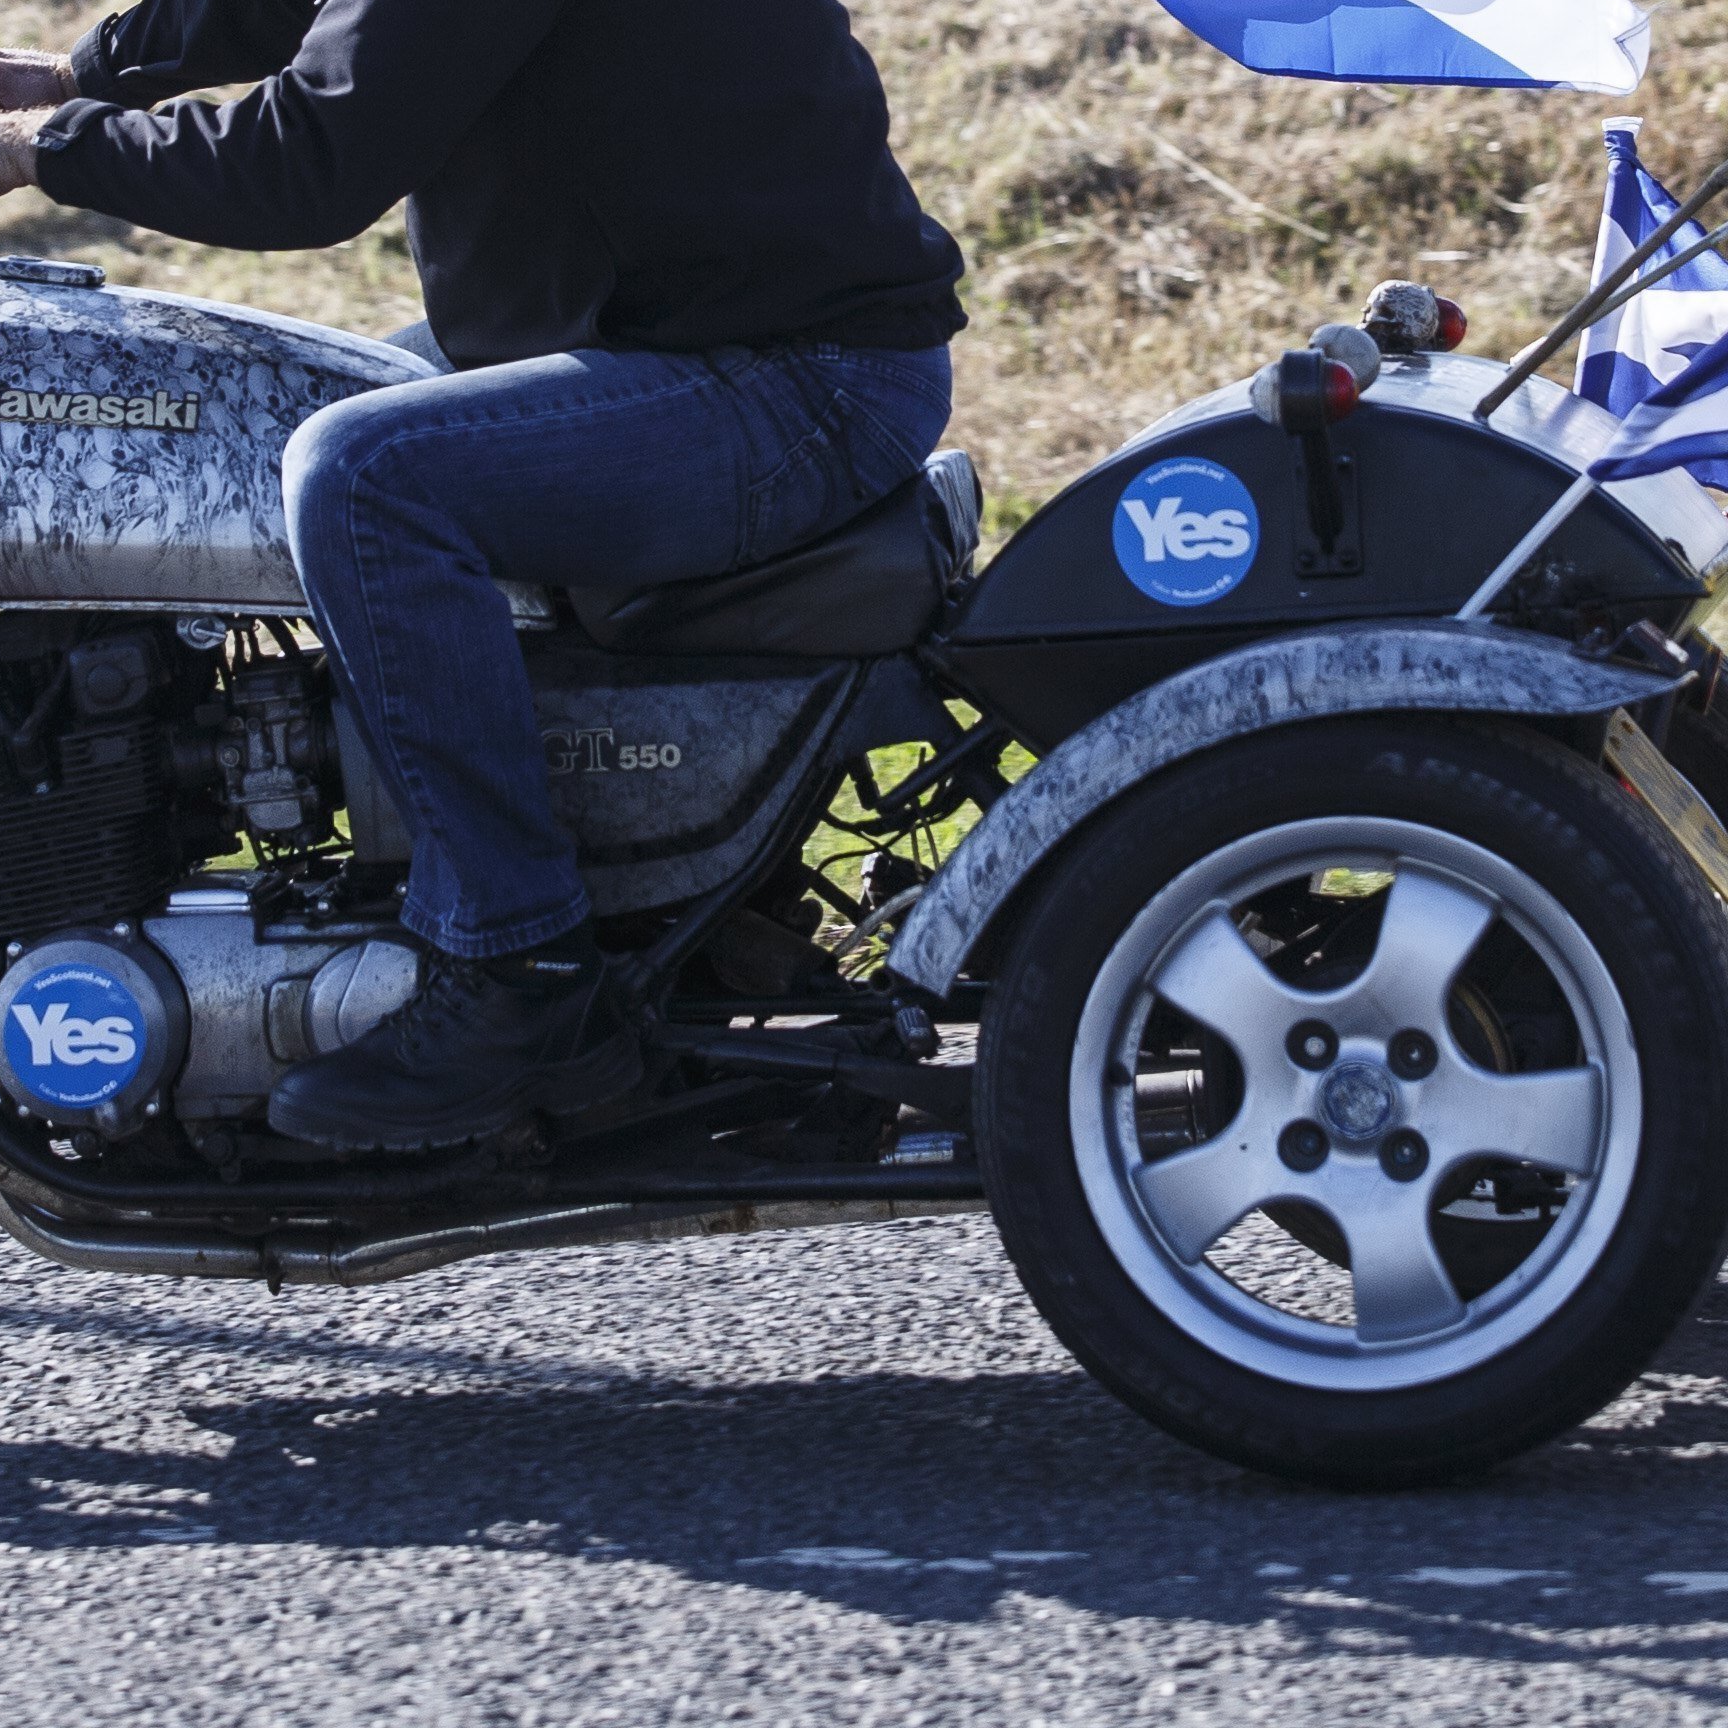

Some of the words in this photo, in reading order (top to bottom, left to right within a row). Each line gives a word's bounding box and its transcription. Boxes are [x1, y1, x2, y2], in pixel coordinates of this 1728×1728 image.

[1121, 496, 1252, 563] Yes
[540, 727, 615, 774] GT
[618, 742, 682, 770] 550
[33, 969, 113, 991] YesScotland.net
[10, 1002, 137, 1066] Yes
